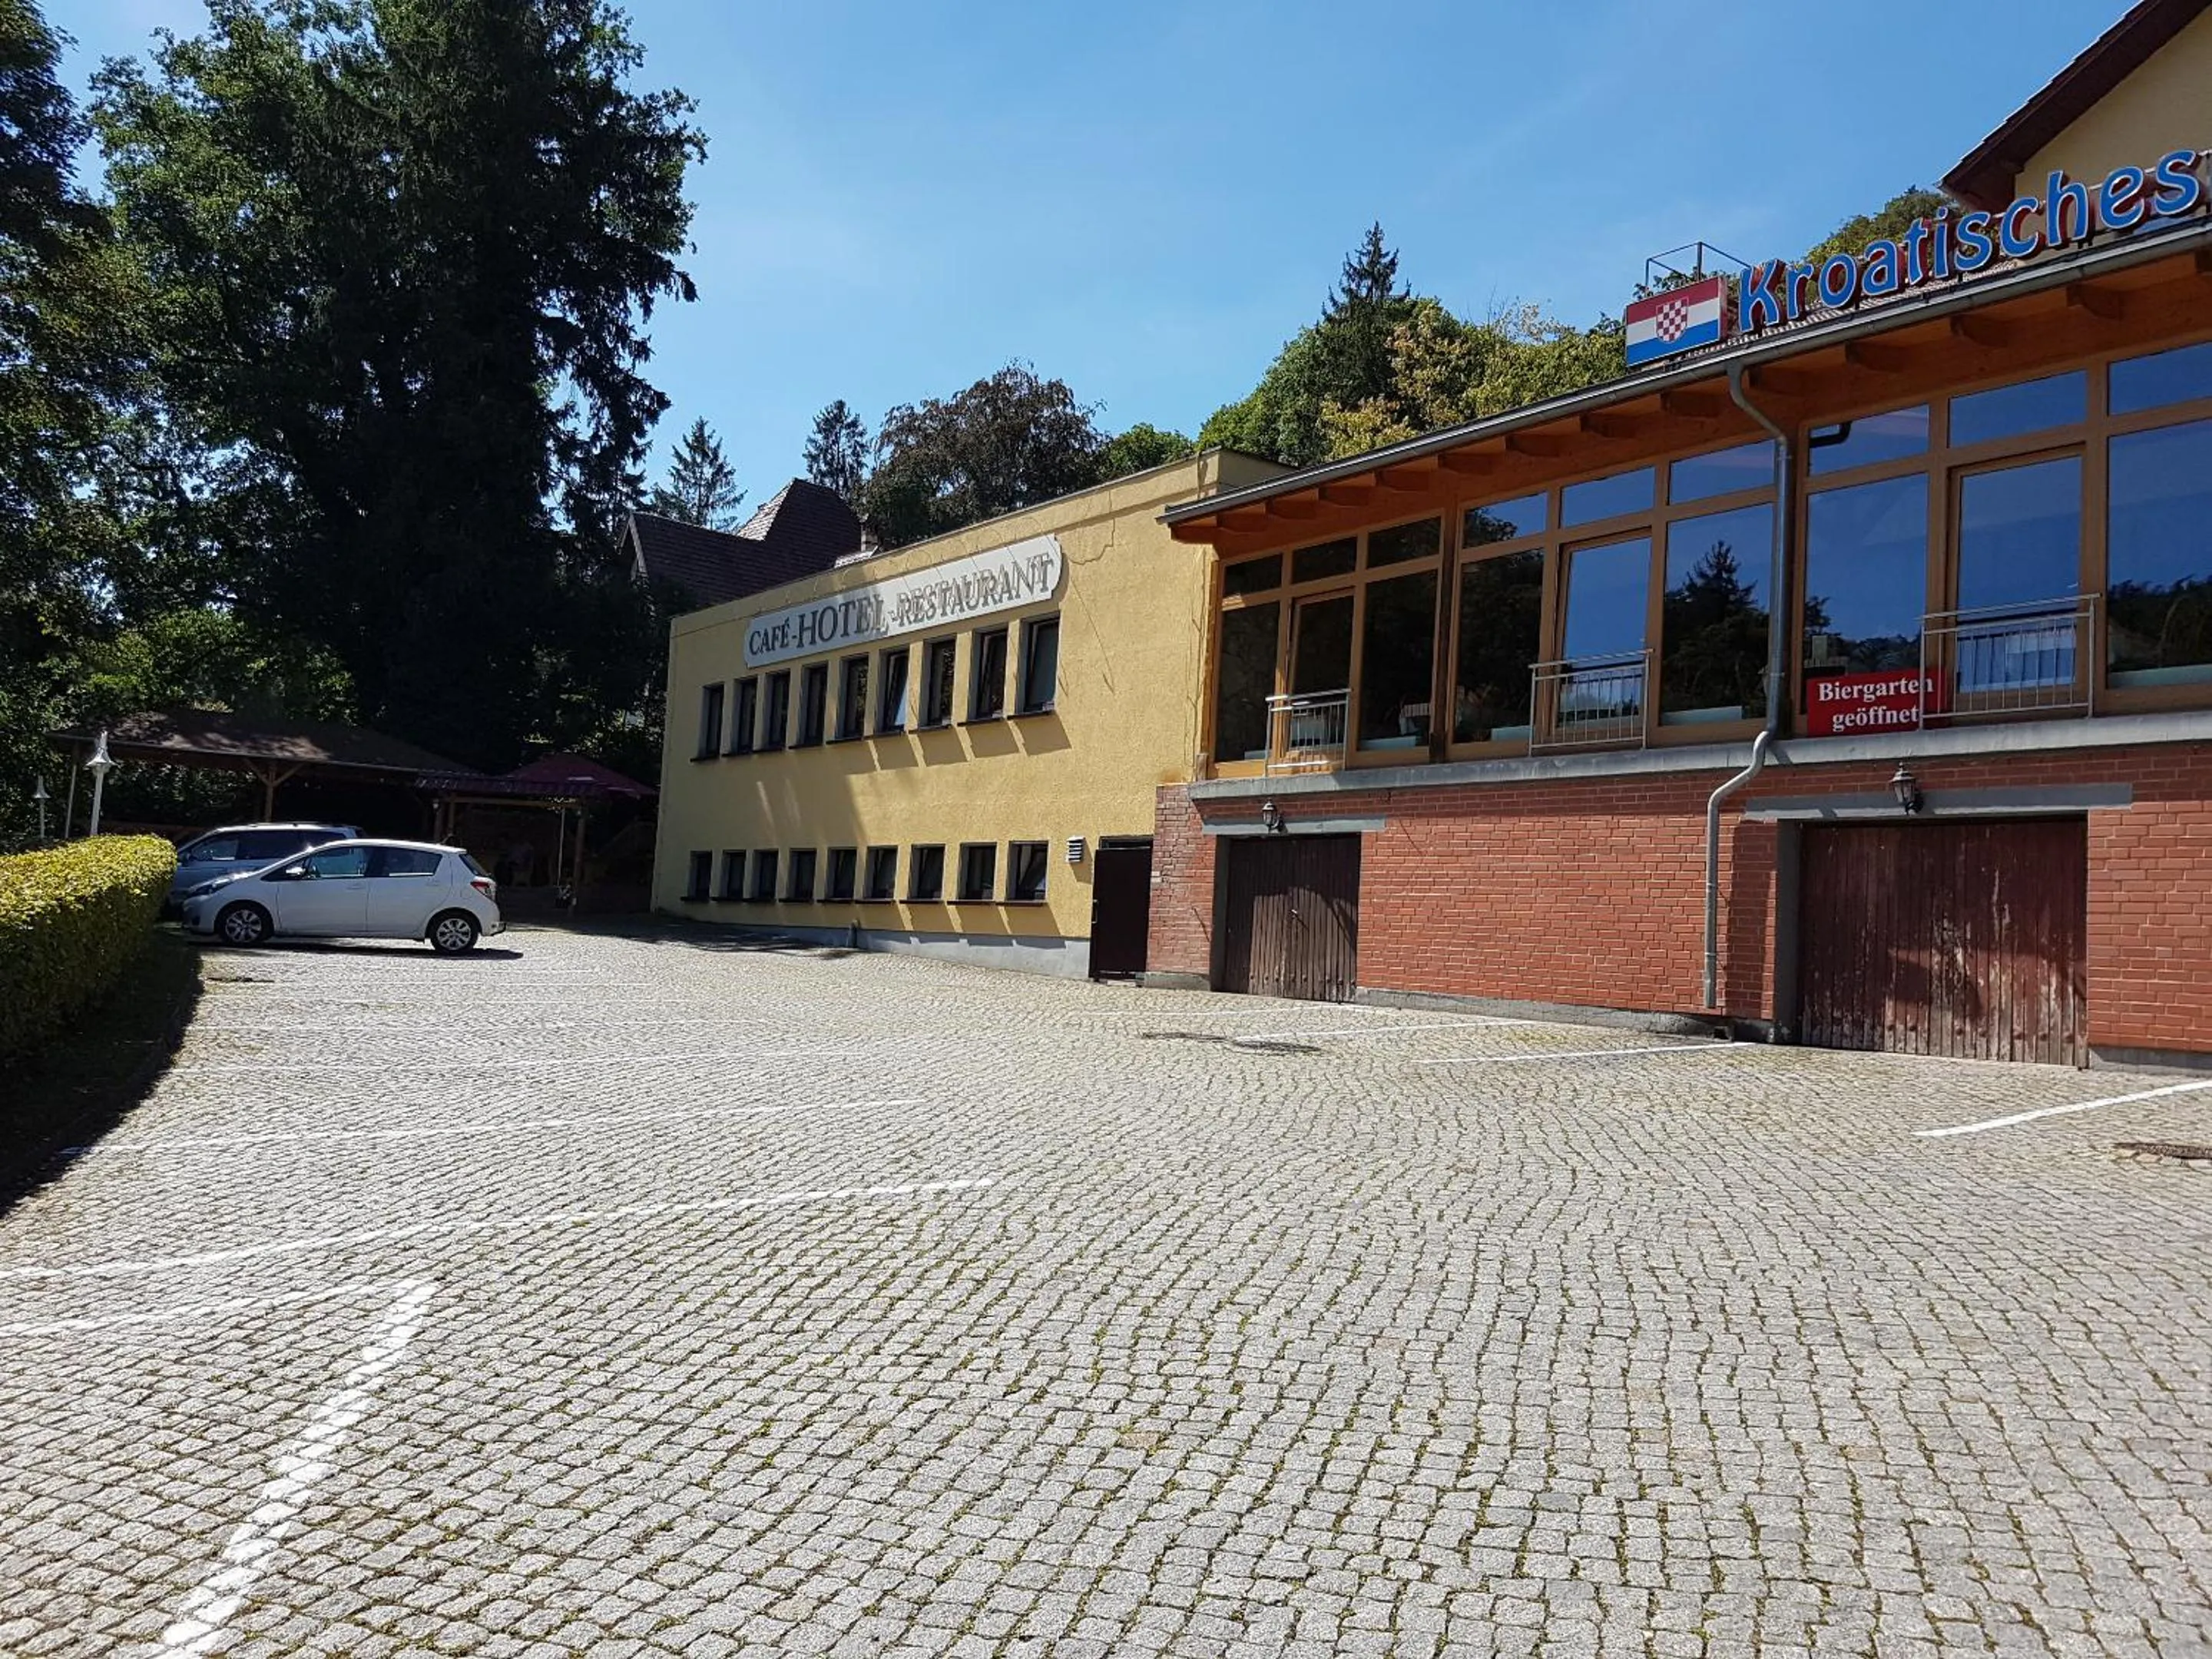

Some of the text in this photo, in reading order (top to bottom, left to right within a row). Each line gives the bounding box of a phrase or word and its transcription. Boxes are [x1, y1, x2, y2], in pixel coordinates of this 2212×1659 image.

[1737, 150, 2200, 333] Kroatisches
[1817, 677, 1934, 703] Biergarten
[1832, 704, 1919, 732] geöffnet
